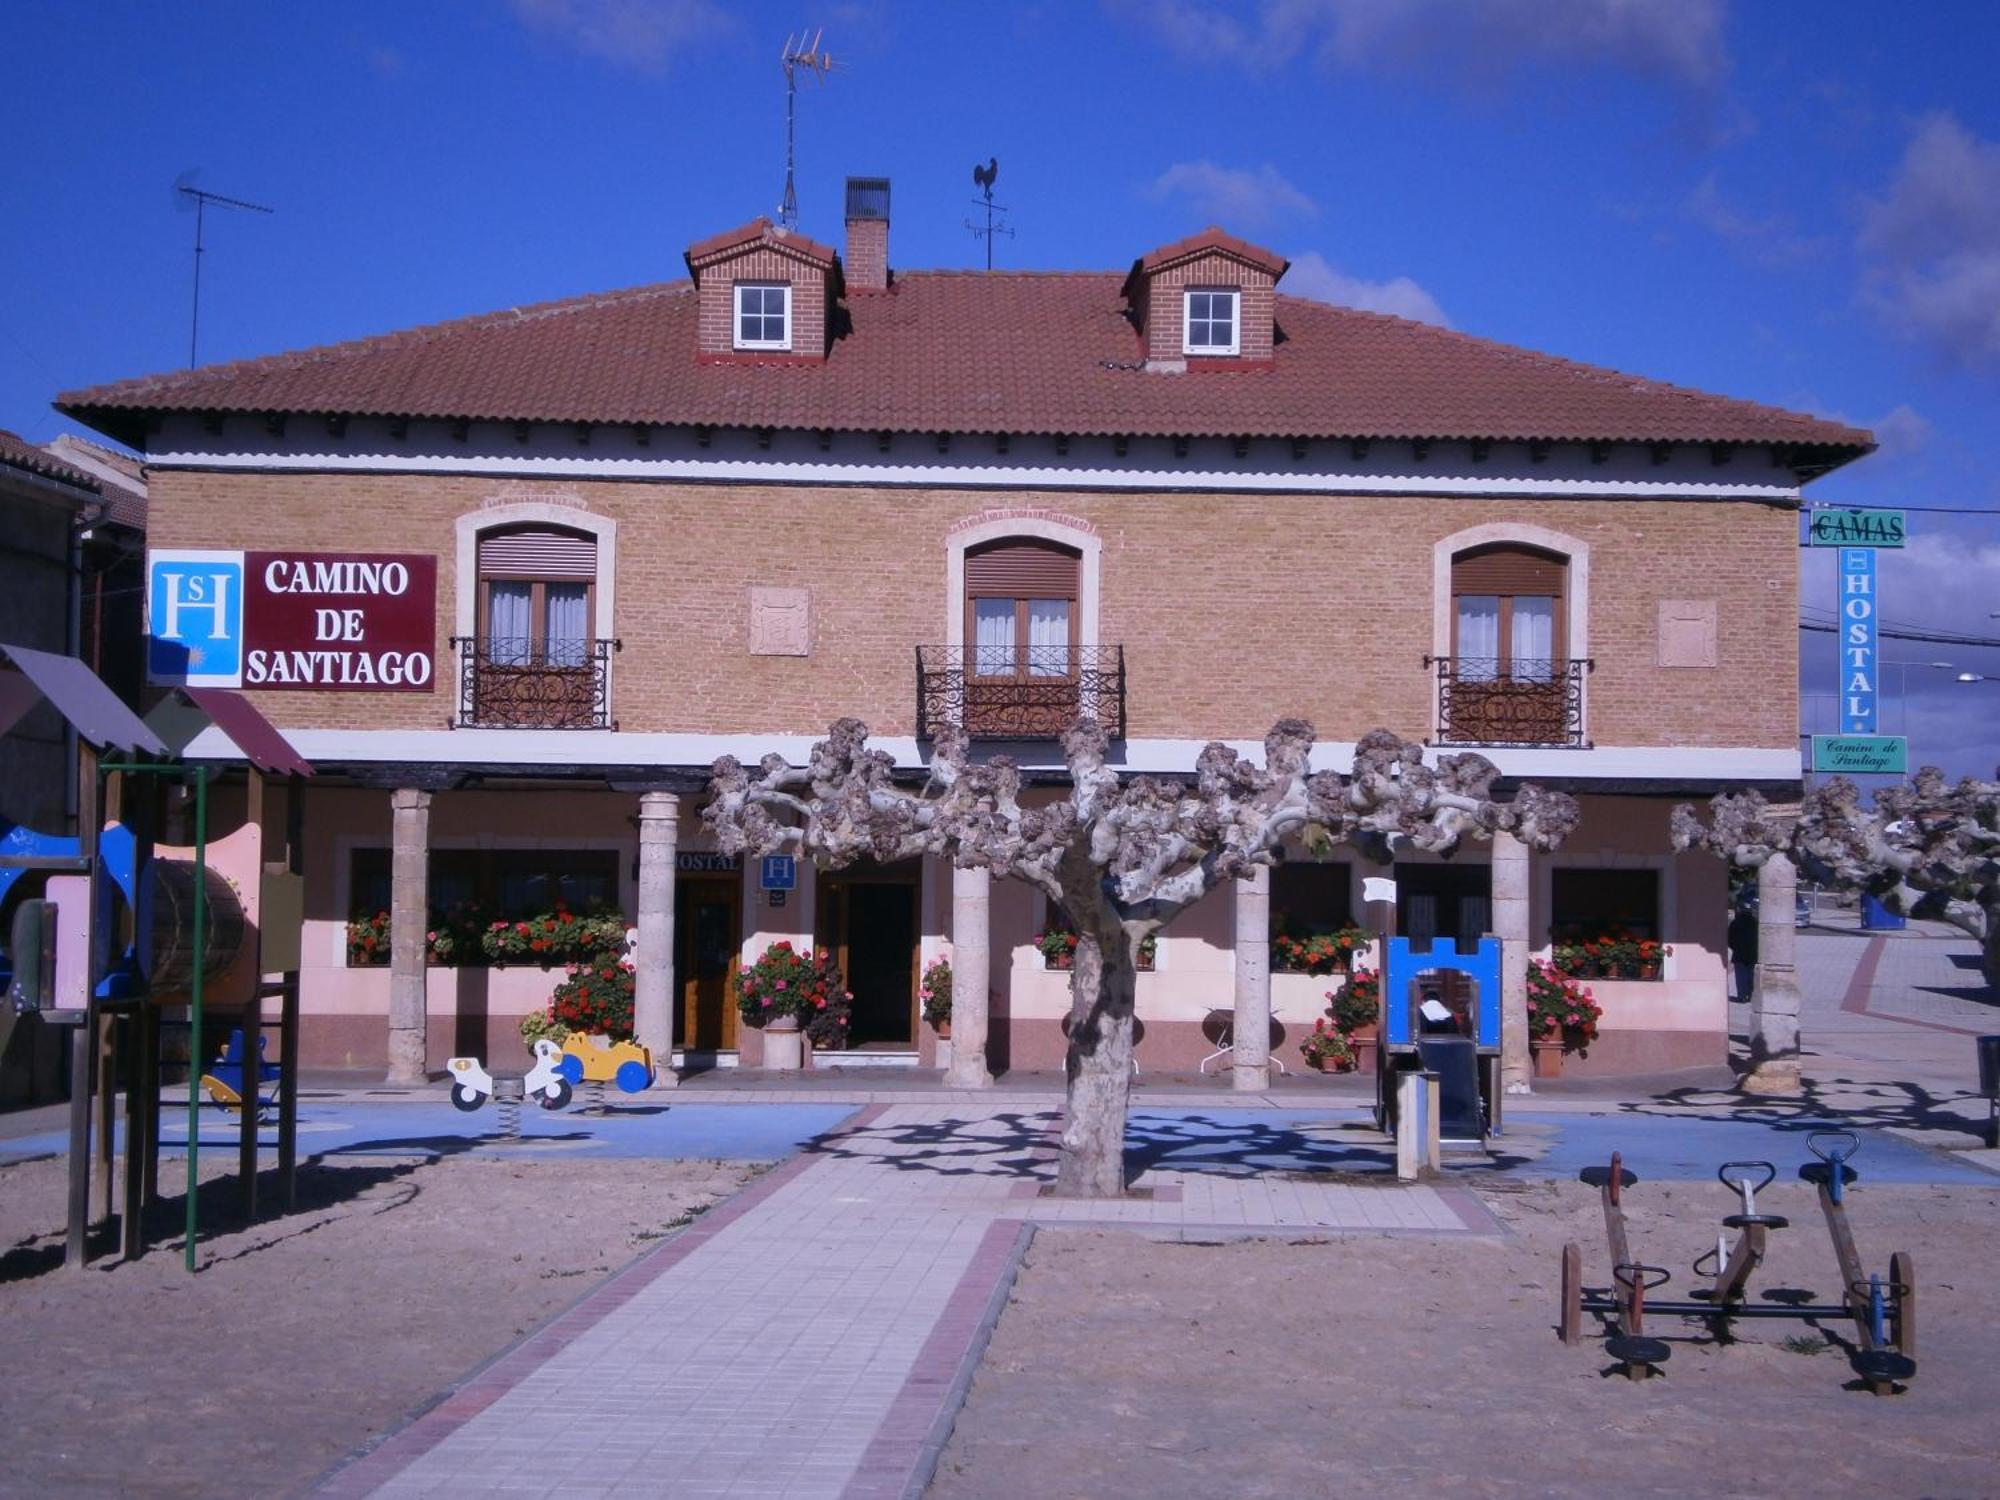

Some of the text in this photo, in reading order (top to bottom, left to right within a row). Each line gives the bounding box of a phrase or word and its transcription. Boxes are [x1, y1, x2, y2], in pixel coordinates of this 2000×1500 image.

[1817, 515, 1904, 542] CAMAS
[264, 560, 409, 595] CAMINO
[315, 609, 365, 641] DE
[1845, 574, 1871, 717] HOSTAL
[246, 650, 431, 684] SANTIAGO
[675, 854, 736, 870] OSTAL
